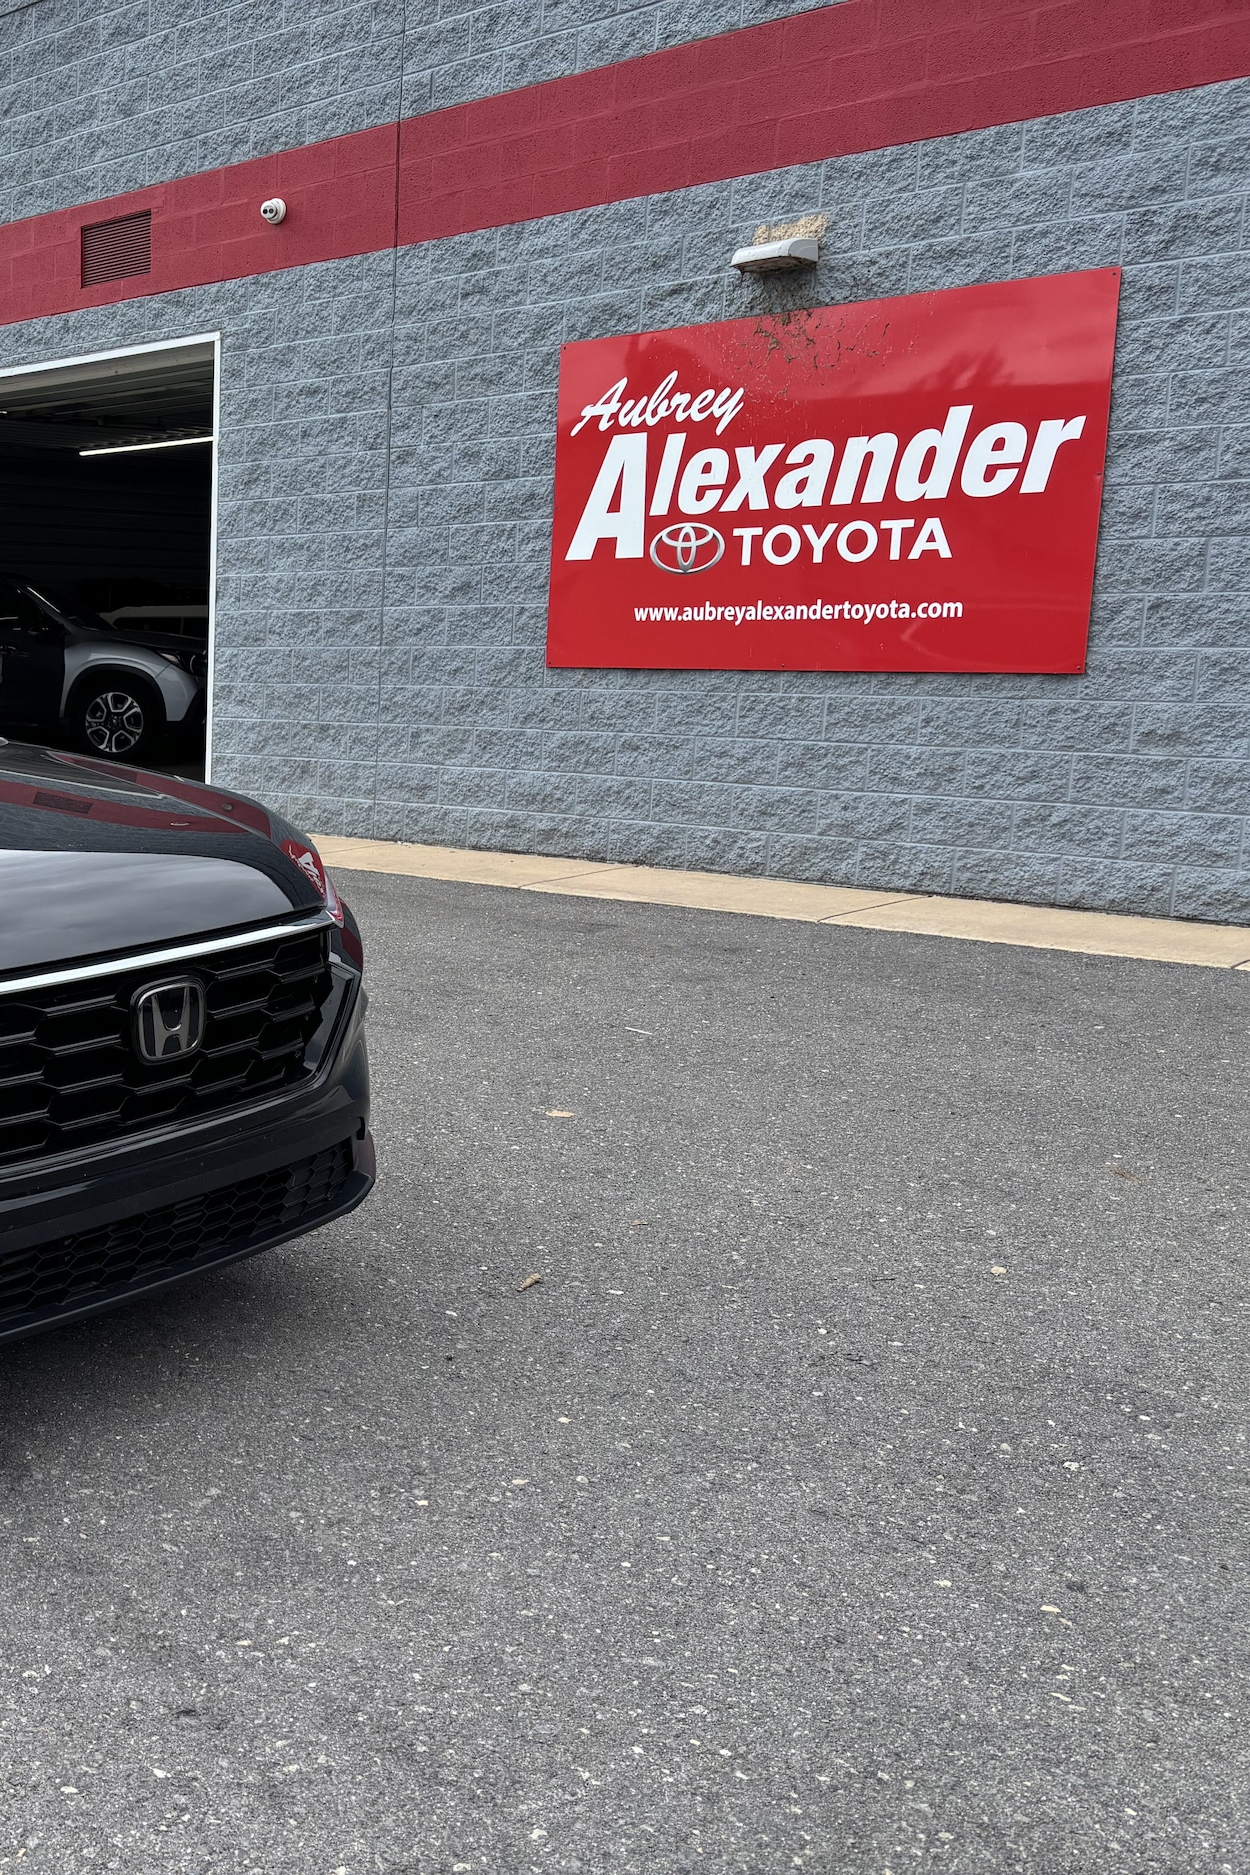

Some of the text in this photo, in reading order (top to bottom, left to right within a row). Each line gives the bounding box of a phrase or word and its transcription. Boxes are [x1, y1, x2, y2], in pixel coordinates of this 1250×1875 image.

[570, 370, 745, 436] Aubrey
[564, 405, 1087, 561] Alexander
[732, 517, 953, 566] TOYOTA
[634, 599, 963, 626] www.aubreyalexandertoyota.com
